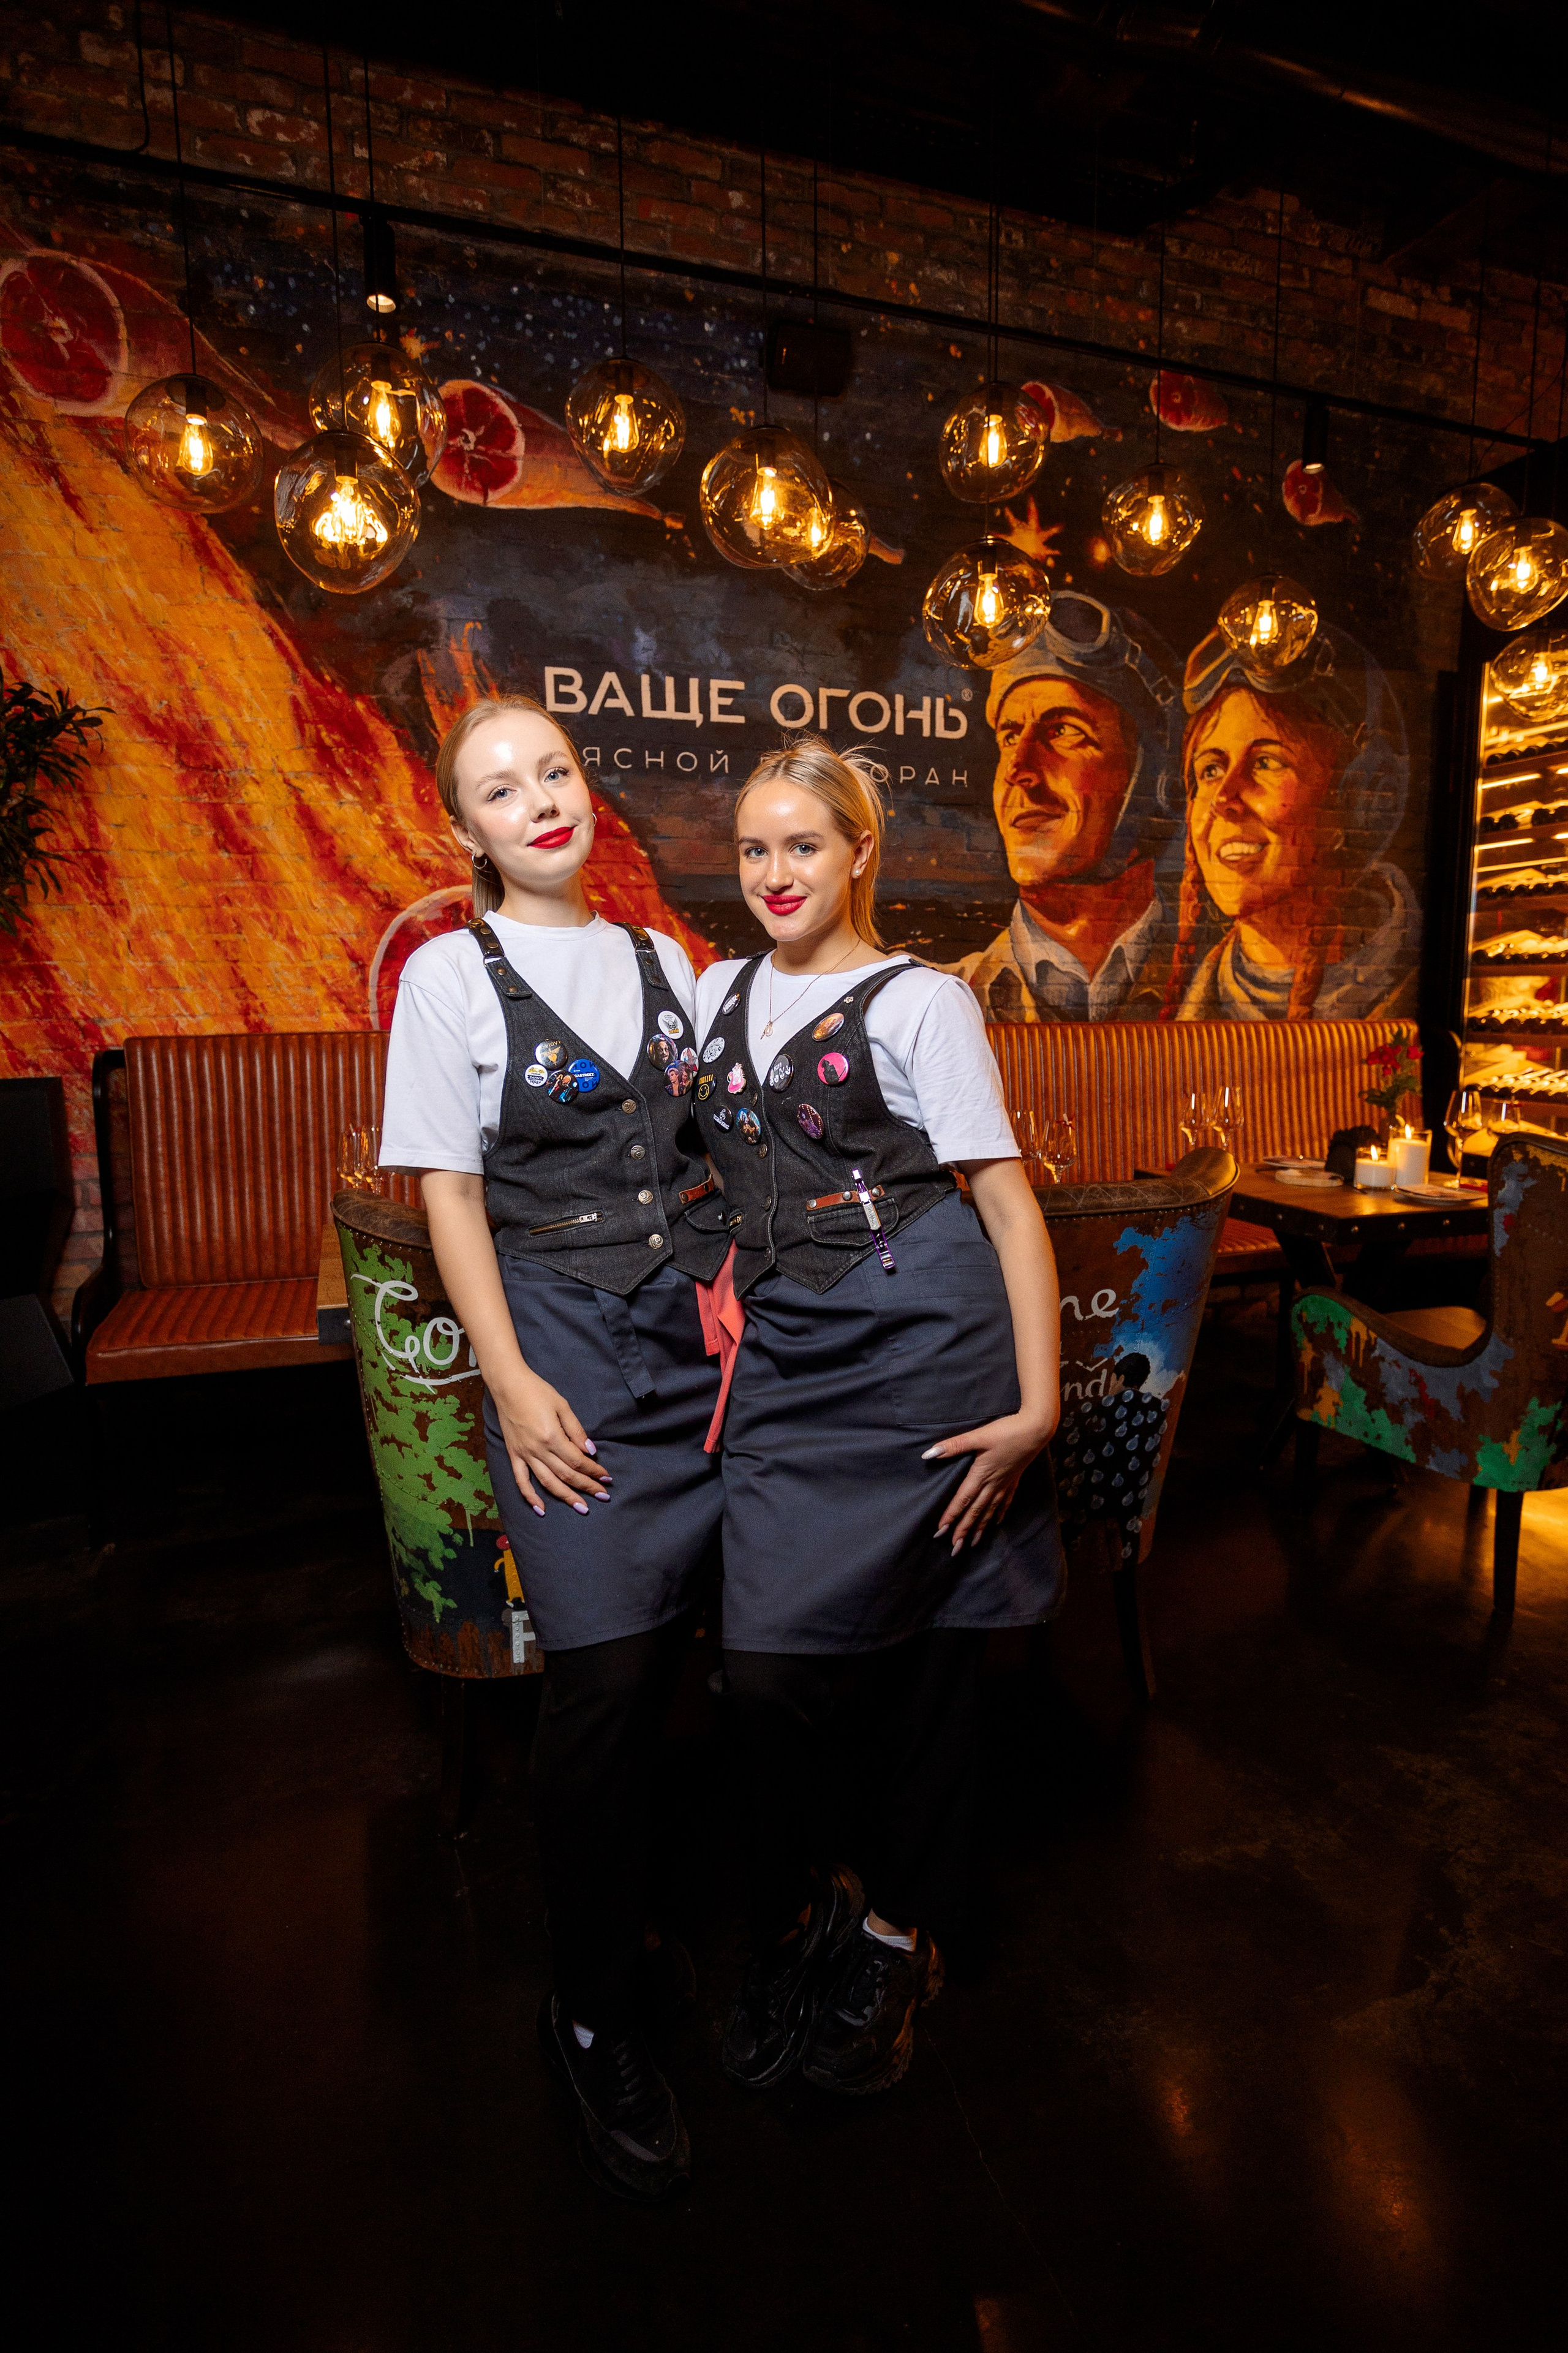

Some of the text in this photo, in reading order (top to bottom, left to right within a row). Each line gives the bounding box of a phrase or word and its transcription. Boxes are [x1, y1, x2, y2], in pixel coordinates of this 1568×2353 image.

[545, 666, 968, 739] ВАЩЕ ОГОНЬ
[582, 747, 968, 788] ЯСНОЙ ОРАН
